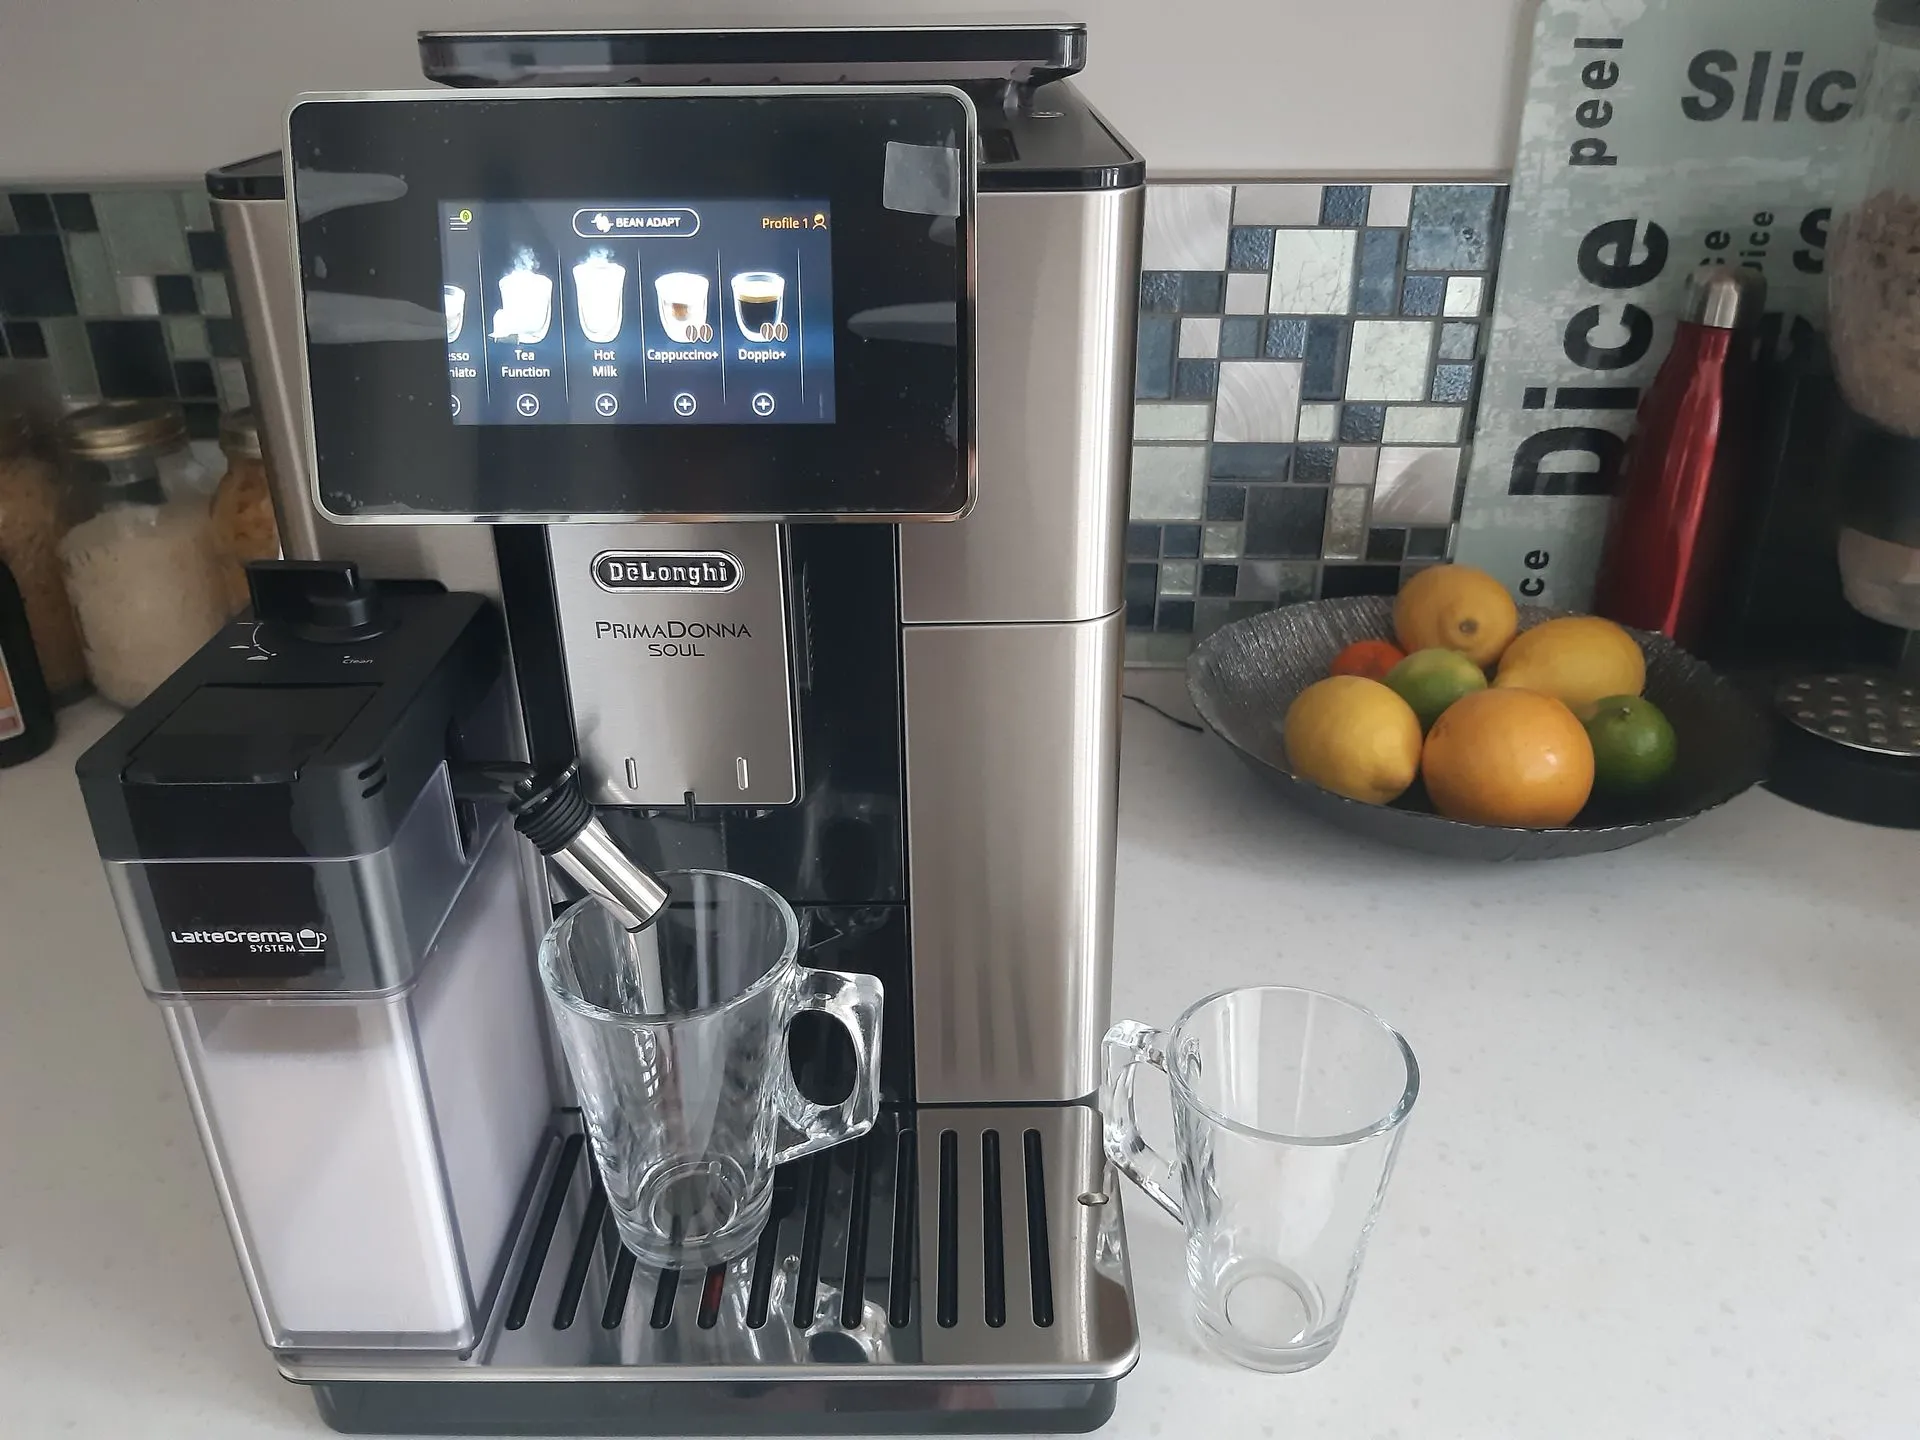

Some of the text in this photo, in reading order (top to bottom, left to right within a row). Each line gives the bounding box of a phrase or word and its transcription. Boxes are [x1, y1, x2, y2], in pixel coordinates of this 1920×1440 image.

[1680, 48, 1858, 122] Slic
[1569, 37, 1625, 167] peel
[615, 216, 681, 228] BEAN ADAPT
[762, 216, 808, 229] Profile 1
[514, 349, 535, 361] Tea
[594, 349, 616, 361] Hot
[647, 349, 719, 363] Cappuccino+
[738, 349, 787, 363] Doppio+
[1508, 217, 1669, 497] Dice
[501, 366, 551, 378] Function
[592, 366, 618, 378] Milk
[648, 643, 705, 657] SOUL
[249, 944, 296, 953] SYSTEM
